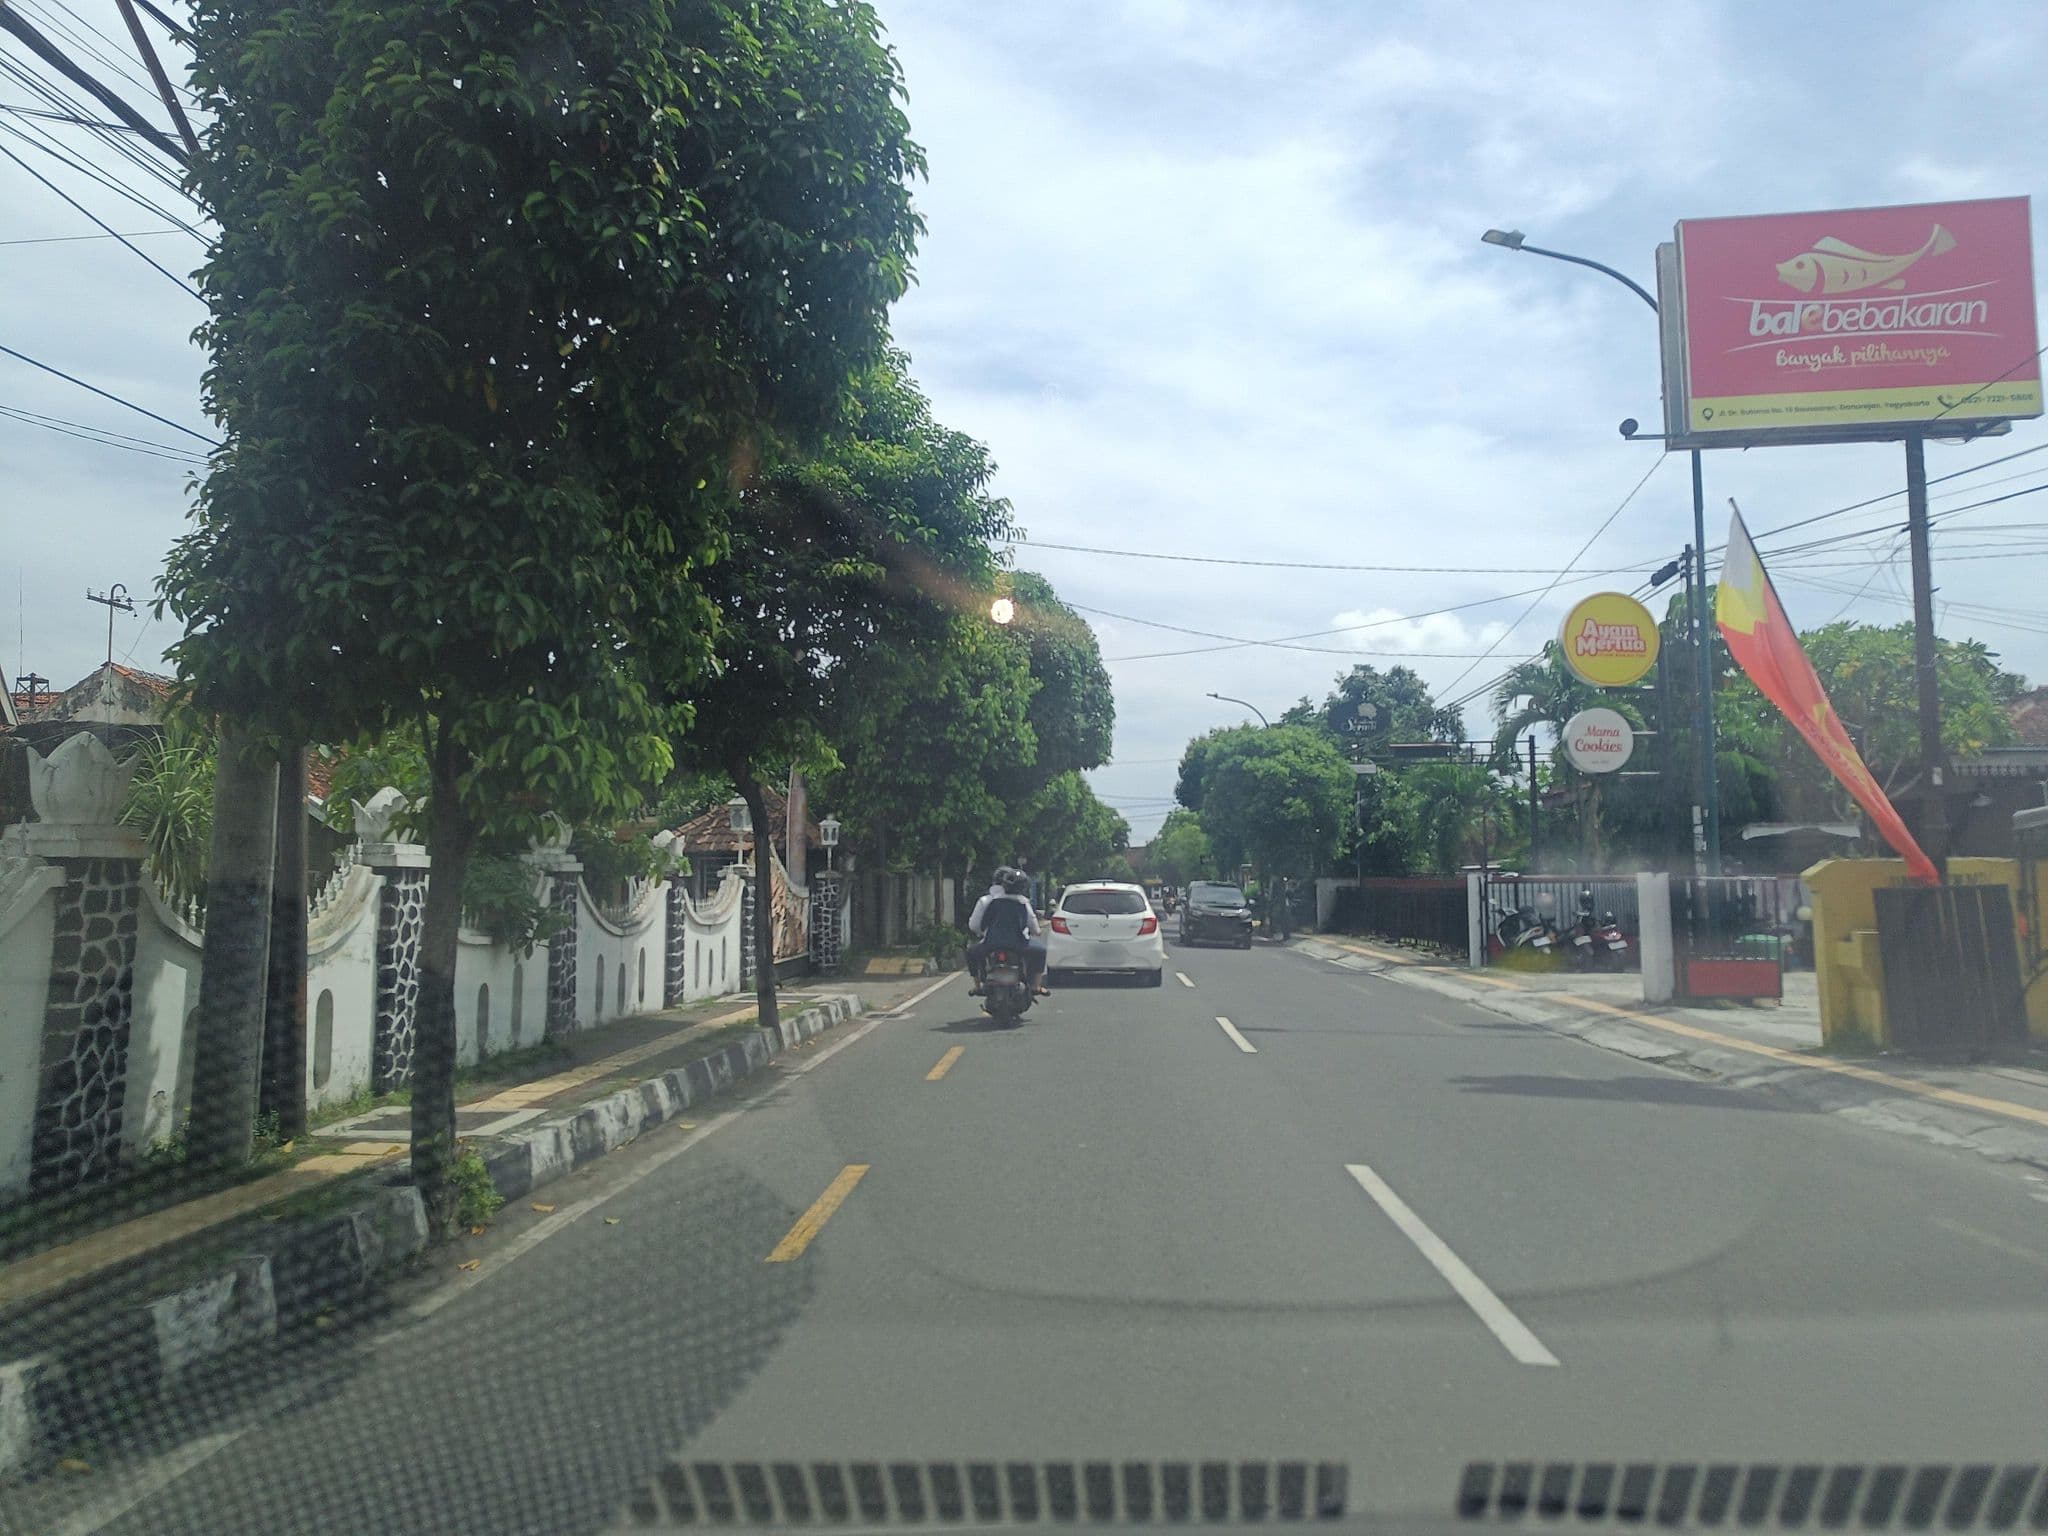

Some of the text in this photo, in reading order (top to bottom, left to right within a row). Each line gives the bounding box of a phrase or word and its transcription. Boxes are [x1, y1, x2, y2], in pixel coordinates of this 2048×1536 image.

[1850, 343, 1951, 368] pilihannya
[1583, 619, 1639, 639] Ayam
[1576, 636, 1646, 656] Mertua
[1585, 725, 1621, 737] Mama
[1575, 738, 1623, 752] Cookies
